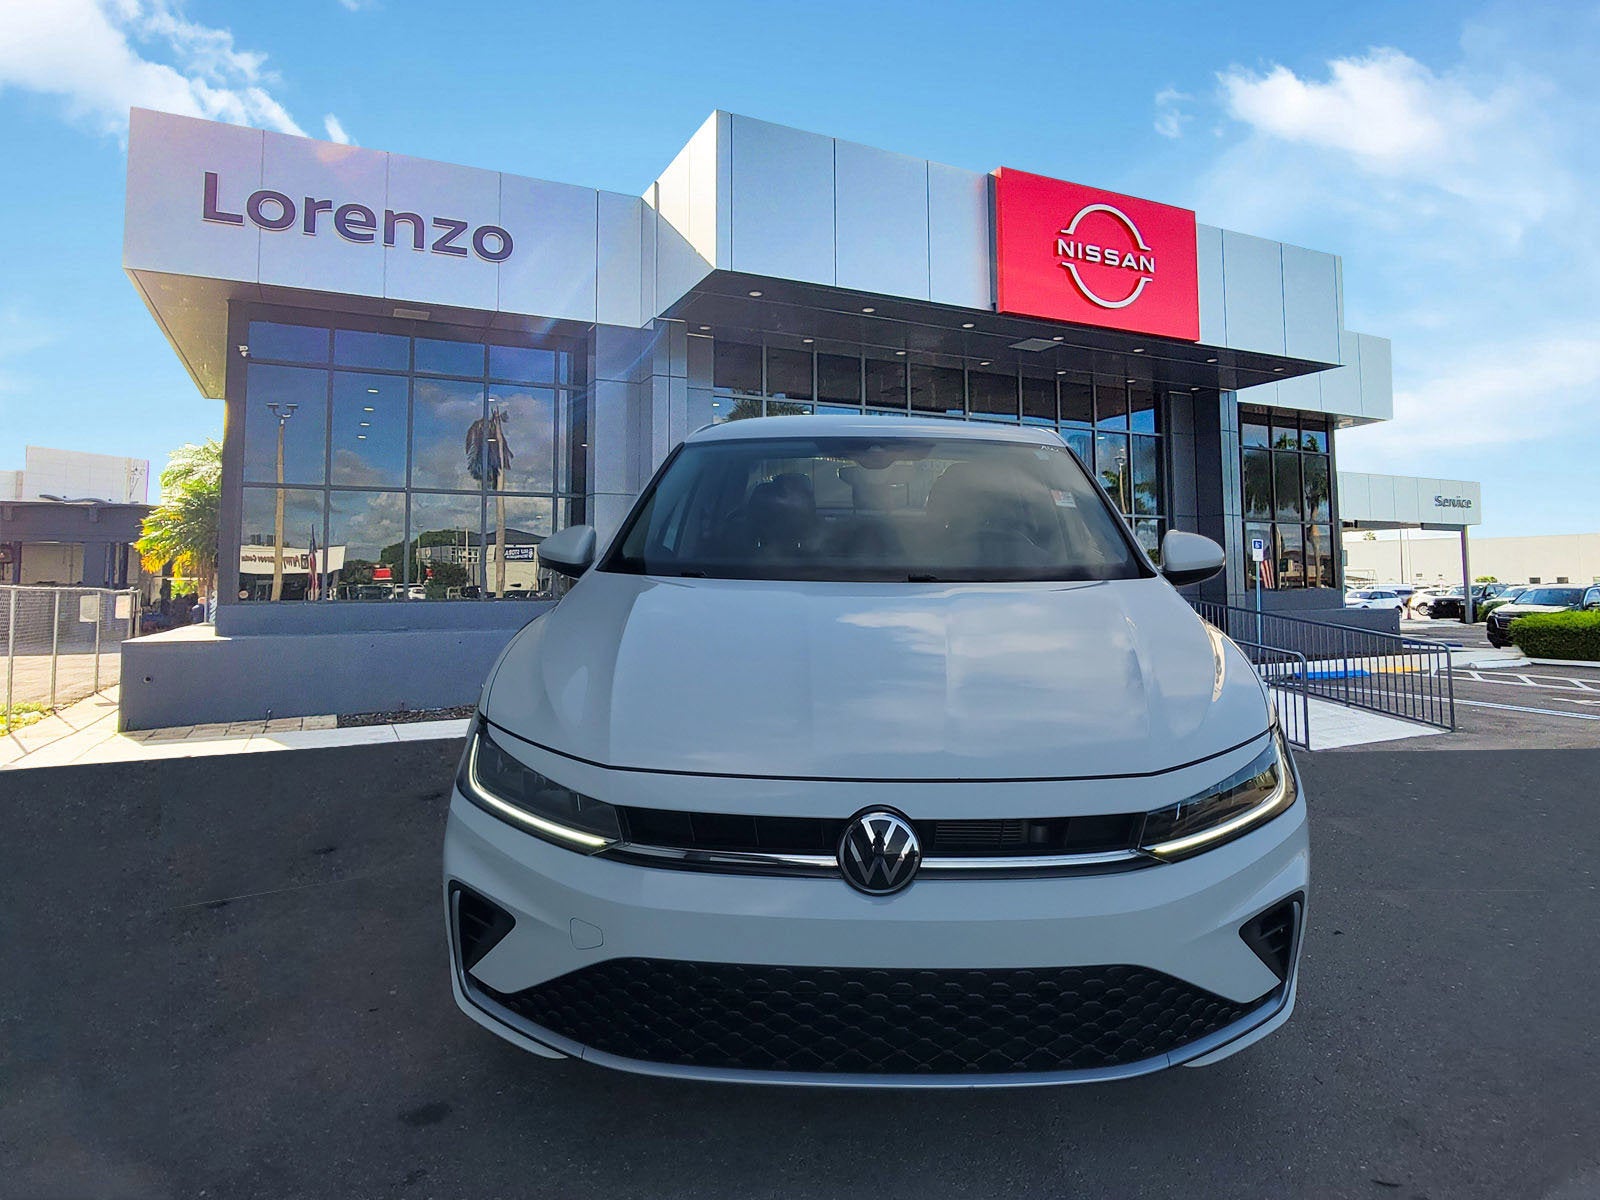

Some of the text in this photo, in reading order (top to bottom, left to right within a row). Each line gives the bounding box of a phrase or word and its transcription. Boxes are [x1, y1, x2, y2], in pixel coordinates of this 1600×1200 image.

[202, 171, 515, 263] Lorenzo
[1056, 238, 1156, 273] NISSAN
[1434, 495, 1472, 509] Service
